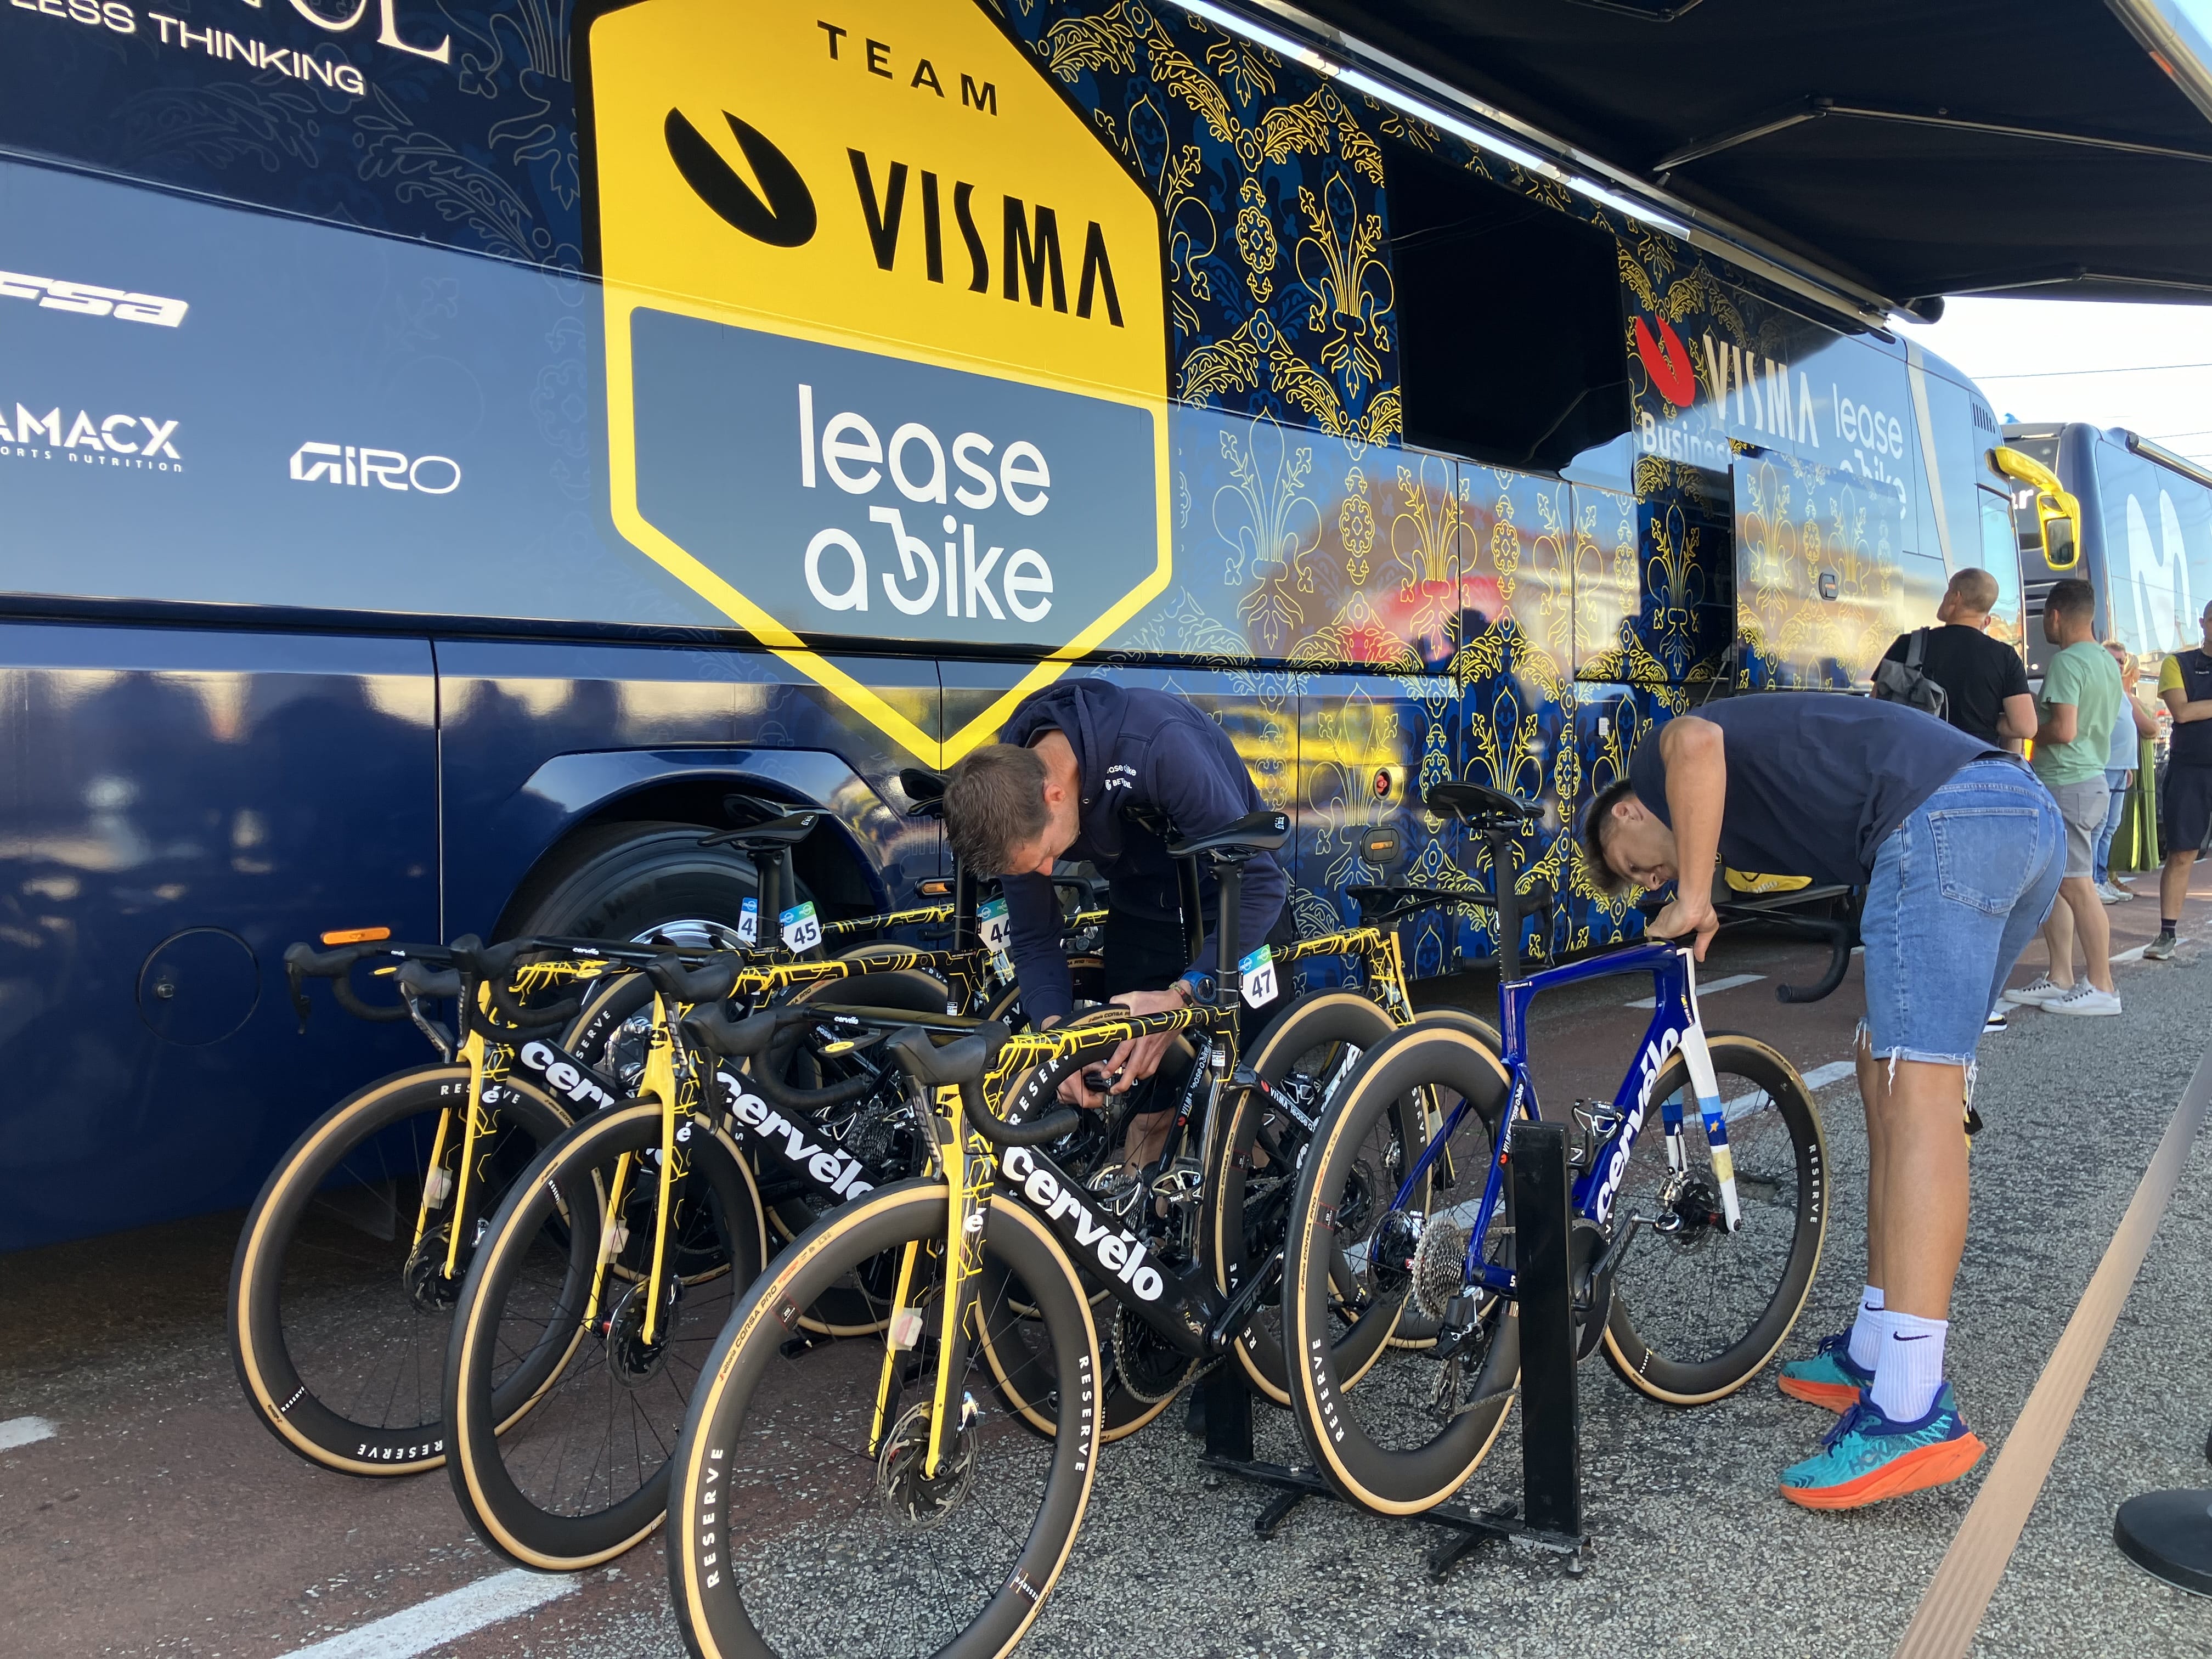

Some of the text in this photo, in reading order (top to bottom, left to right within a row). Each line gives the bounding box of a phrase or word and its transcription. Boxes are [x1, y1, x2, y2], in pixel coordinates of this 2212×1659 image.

[148, 12, 365, 95] THINKING
[817, 20, 997, 116] TEAM
[846, 147, 1125, 329] VISMA
[1703, 334, 1903, 460] VISMA lease
[798, 383, 1051, 516] lease
[741, 918, 757, 936] 4
[794, 921, 817, 945] 45
[991, 919, 1012, 943] 44
[1252, 969, 1271, 998] 47
[575, 1010, 611, 1059] SERVE
[1009, 1055, 1070, 1125] RESERV
[1270, 1086, 1288, 1110] VISMA
[1169, 1193, 1184, 1203] Tacx
[1809, 1143, 1820, 1224] RESERVE
[964, 1207, 987, 1232] é
[1002, 1146, 1163, 1301] cervélo
[1304, 1224, 1312, 1261] CORSA
[735, 1309, 760, 1348] CORSA
[760, 1285, 777, 1308] PRO
[1075, 1355, 1092, 1472] RESERVE
[1312, 1338, 1345, 1442] RESERVE
[357, 1440, 443, 1459] RESERVE
[702, 1448, 724, 1588] RESERVE
